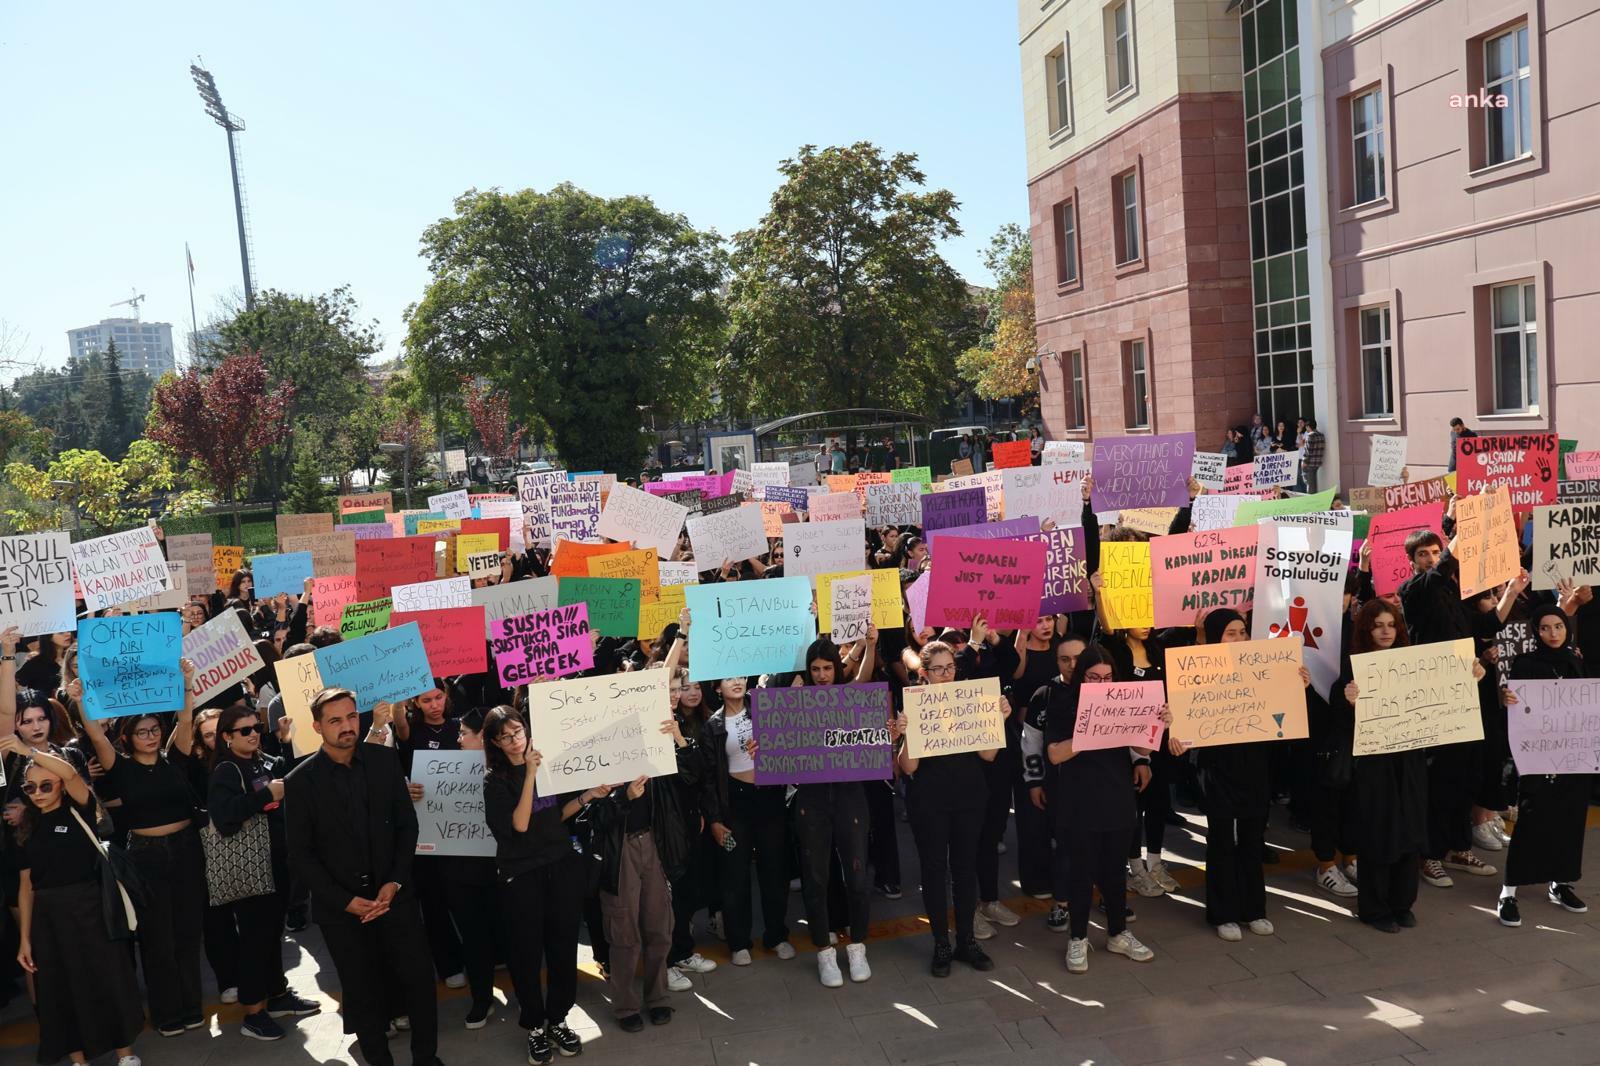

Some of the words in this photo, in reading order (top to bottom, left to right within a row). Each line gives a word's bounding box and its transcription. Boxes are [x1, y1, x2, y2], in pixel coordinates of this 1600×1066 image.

[1094, 443, 1169, 462] EVERYTHING
[1174, 440, 1184, 457] IS
[1114, 460, 1173, 477] POLITICAL
[1487, 464, 1515, 477] DAHA
[523, 472, 568, 489] ANNEDEN
[551, 483, 577, 494] GIRLS
[578, 481, 600, 493] JUST
[949, 480, 966, 489] SEN
[971, 478, 983, 486] BU
[1096, 476, 1132, 494] WHEN
[1172, 471, 1187, 488] A
[551, 493, 579, 505] WANNA
[580, 491, 600, 502] HAVE
[552, 519, 585, 530] human
[1549, 506, 1600, 529] KADIN
[1193, 532, 1227, 549] 6284
[78, 553, 121, 578] KALAN
[958, 551, 1018, 568] WOMEN
[1165, 550, 1213, 570] KADININ
[1265, 547, 1342, 568] Sosyoloji
[82, 568, 145, 597] KADINLAR
[954, 570, 984, 585] JUST
[993, 574, 1031, 585] WANT
[1191, 564, 1247, 587] KADINA
[1263, 564, 1339, 584] Topluluğu
[97, 580, 160, 610] BURADAYIZ
[1040, 578, 1085, 600] ACAK
[716, 597, 799, 618] İSTANBUL
[502, 606, 579, 638] SUSMA!!!
[841, 620, 865, 640] YOK
[524, 642, 560, 664] SANA
[1522, 637, 1538, 654] FE
[502, 650, 581, 683] GELECEK
[1177, 655, 1228, 672] VATANI
[1239, 649, 1297, 666] KORUMAK
[191, 645, 258, 698] URDUDUR
[1253, 670, 1272, 681] VE
[550, 685, 597, 711] She's
[843, 686, 888, 709] SOKAK
[918, 691, 950, 707] SANA
[954, 686, 985, 700] RUH
[1105, 687, 1145, 701] KADIN
[1541, 681, 1600, 712] DİKKAT
[757, 709, 856, 729] HAYVANLARINI
[947, 717, 997, 734] KADININ
[1540, 714, 1559, 735] BU
[426, 759, 463, 776] GECE
[757, 753, 825, 774] SOKAKTAN
[426, 800, 443, 814] BU
